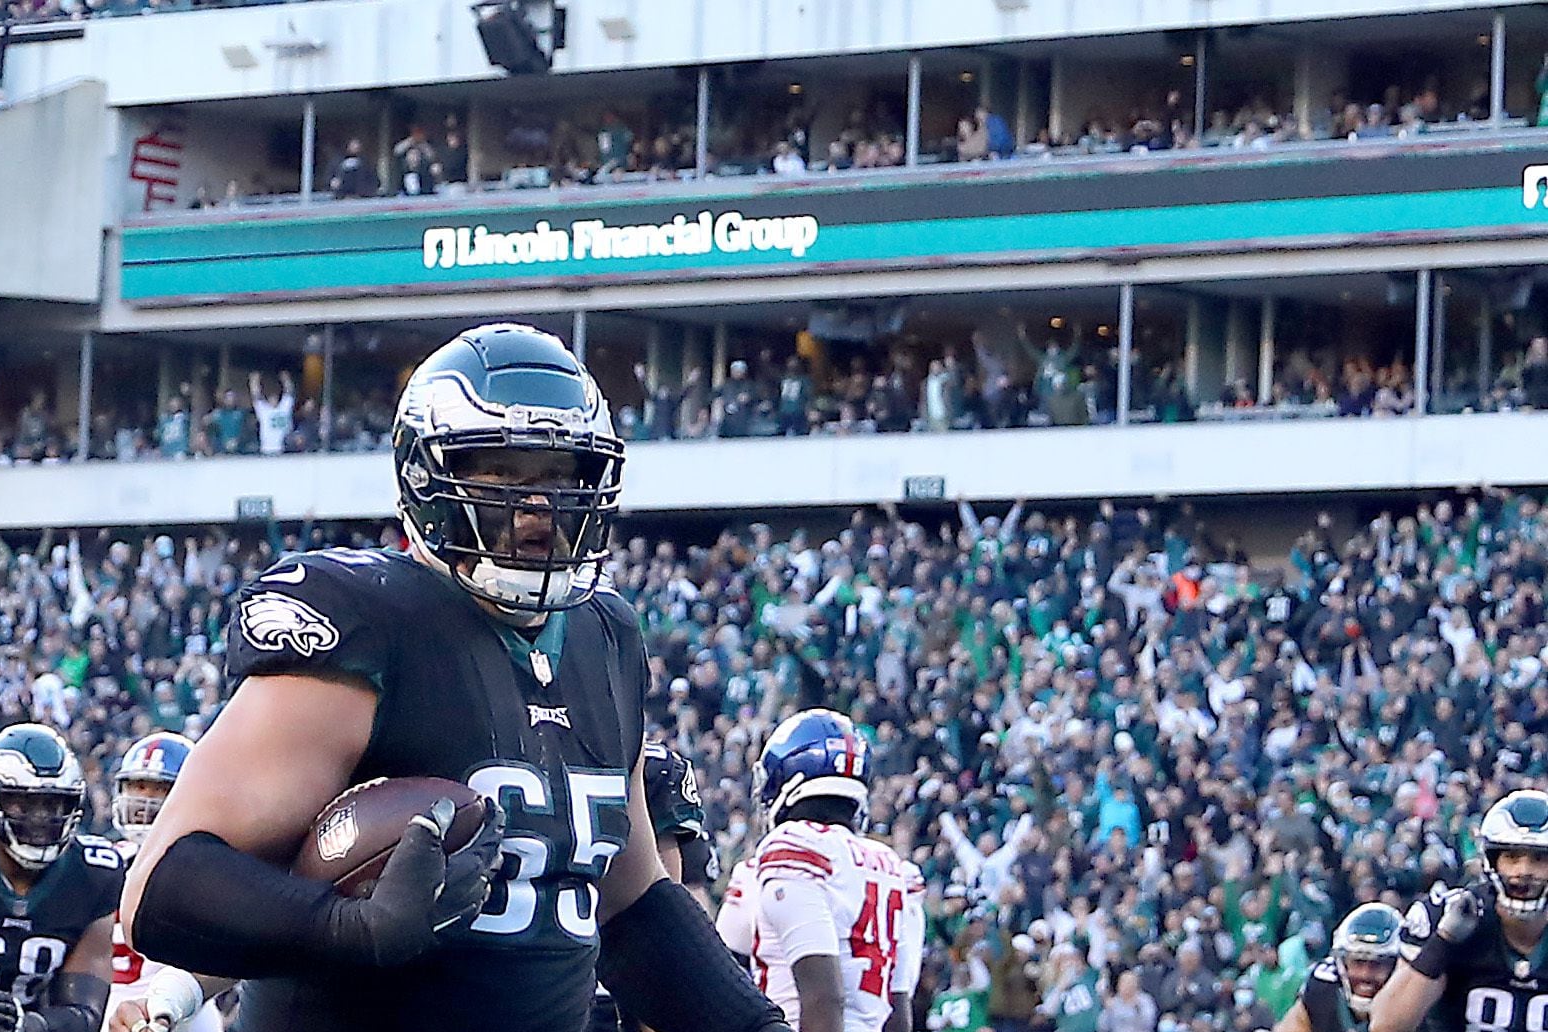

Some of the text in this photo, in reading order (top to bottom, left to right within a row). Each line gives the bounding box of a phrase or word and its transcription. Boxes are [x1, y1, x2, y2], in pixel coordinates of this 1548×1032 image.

[456, 210, 818, 266] Lincoln Financial Group
[468, 766, 627, 937] 65
